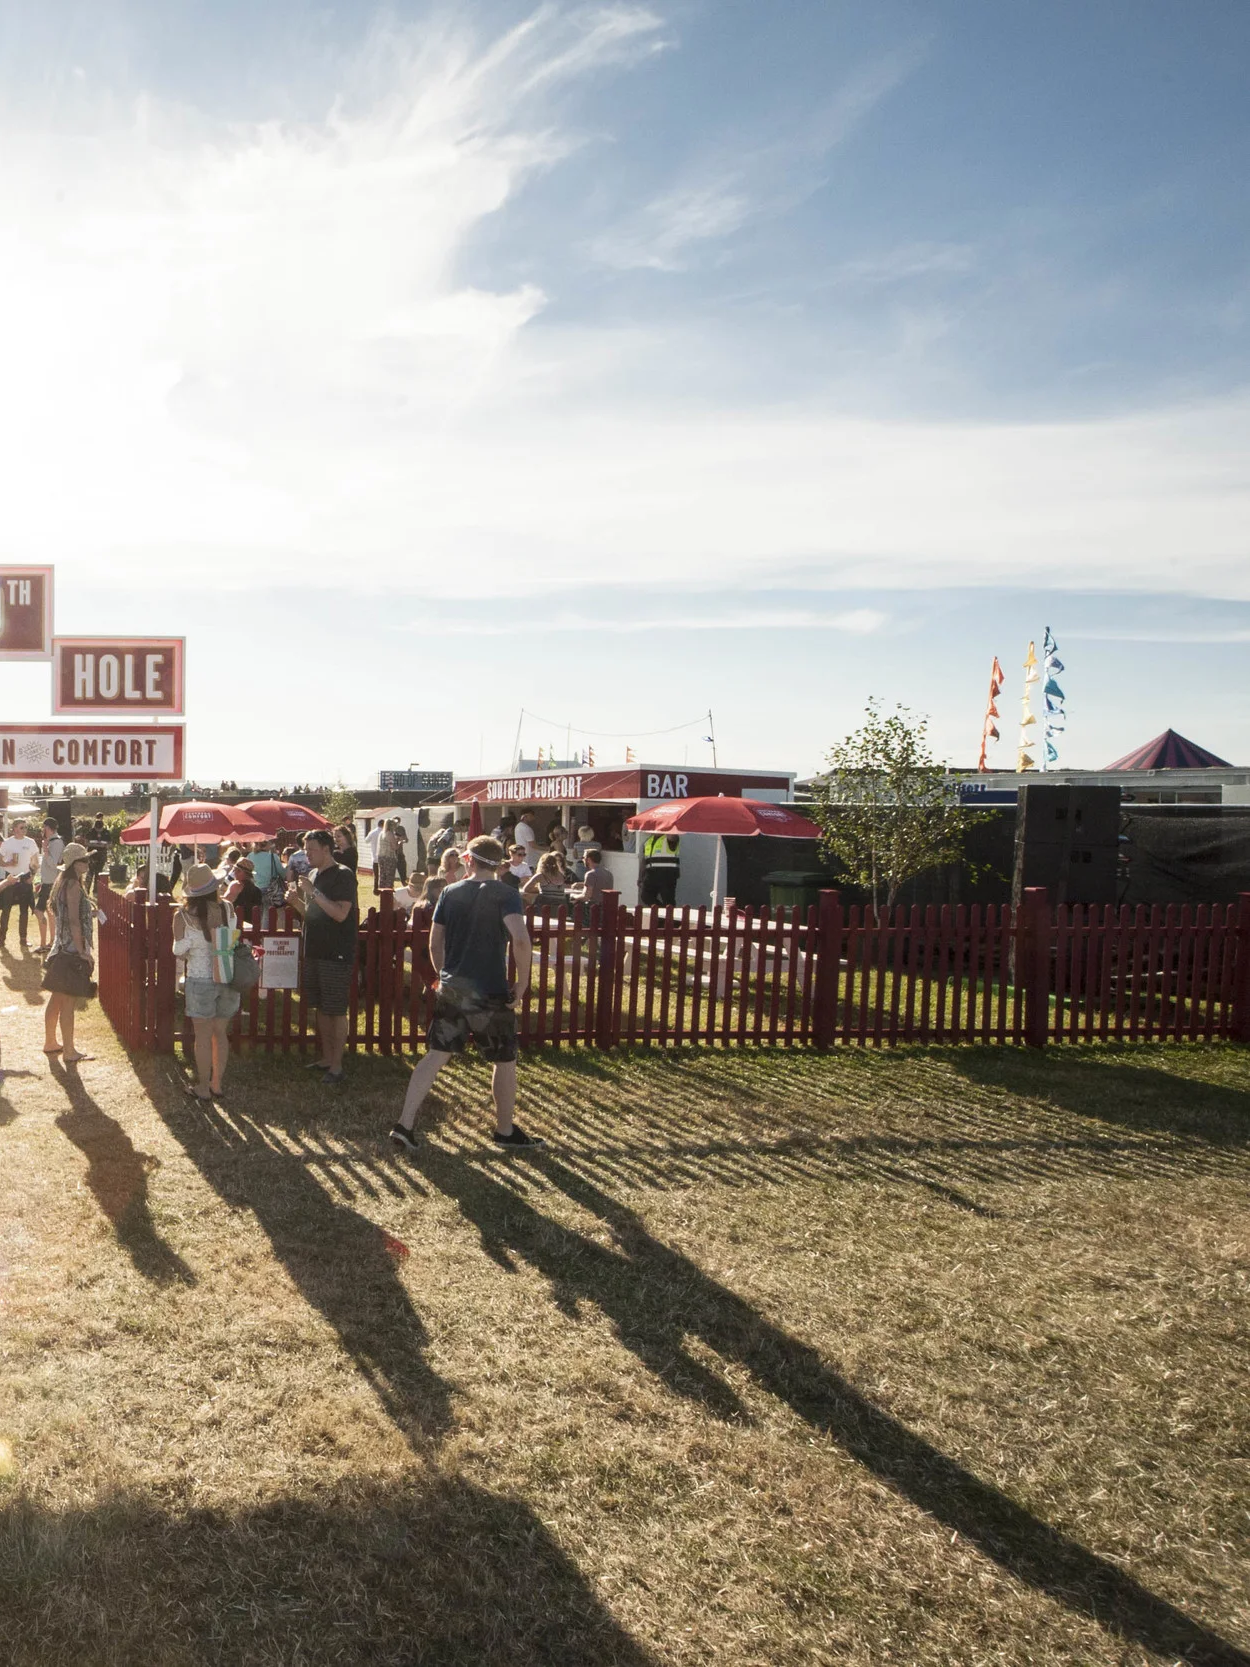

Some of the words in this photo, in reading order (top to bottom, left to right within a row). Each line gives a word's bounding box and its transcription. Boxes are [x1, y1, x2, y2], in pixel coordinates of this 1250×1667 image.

[73, 654, 164, 700] HOLE
[52, 738, 157, 766] COMFORT
[486, 778, 532, 800] SOUTHERN
[534, 776, 582, 798] COMFORT
[647, 774, 689, 798] BAR
